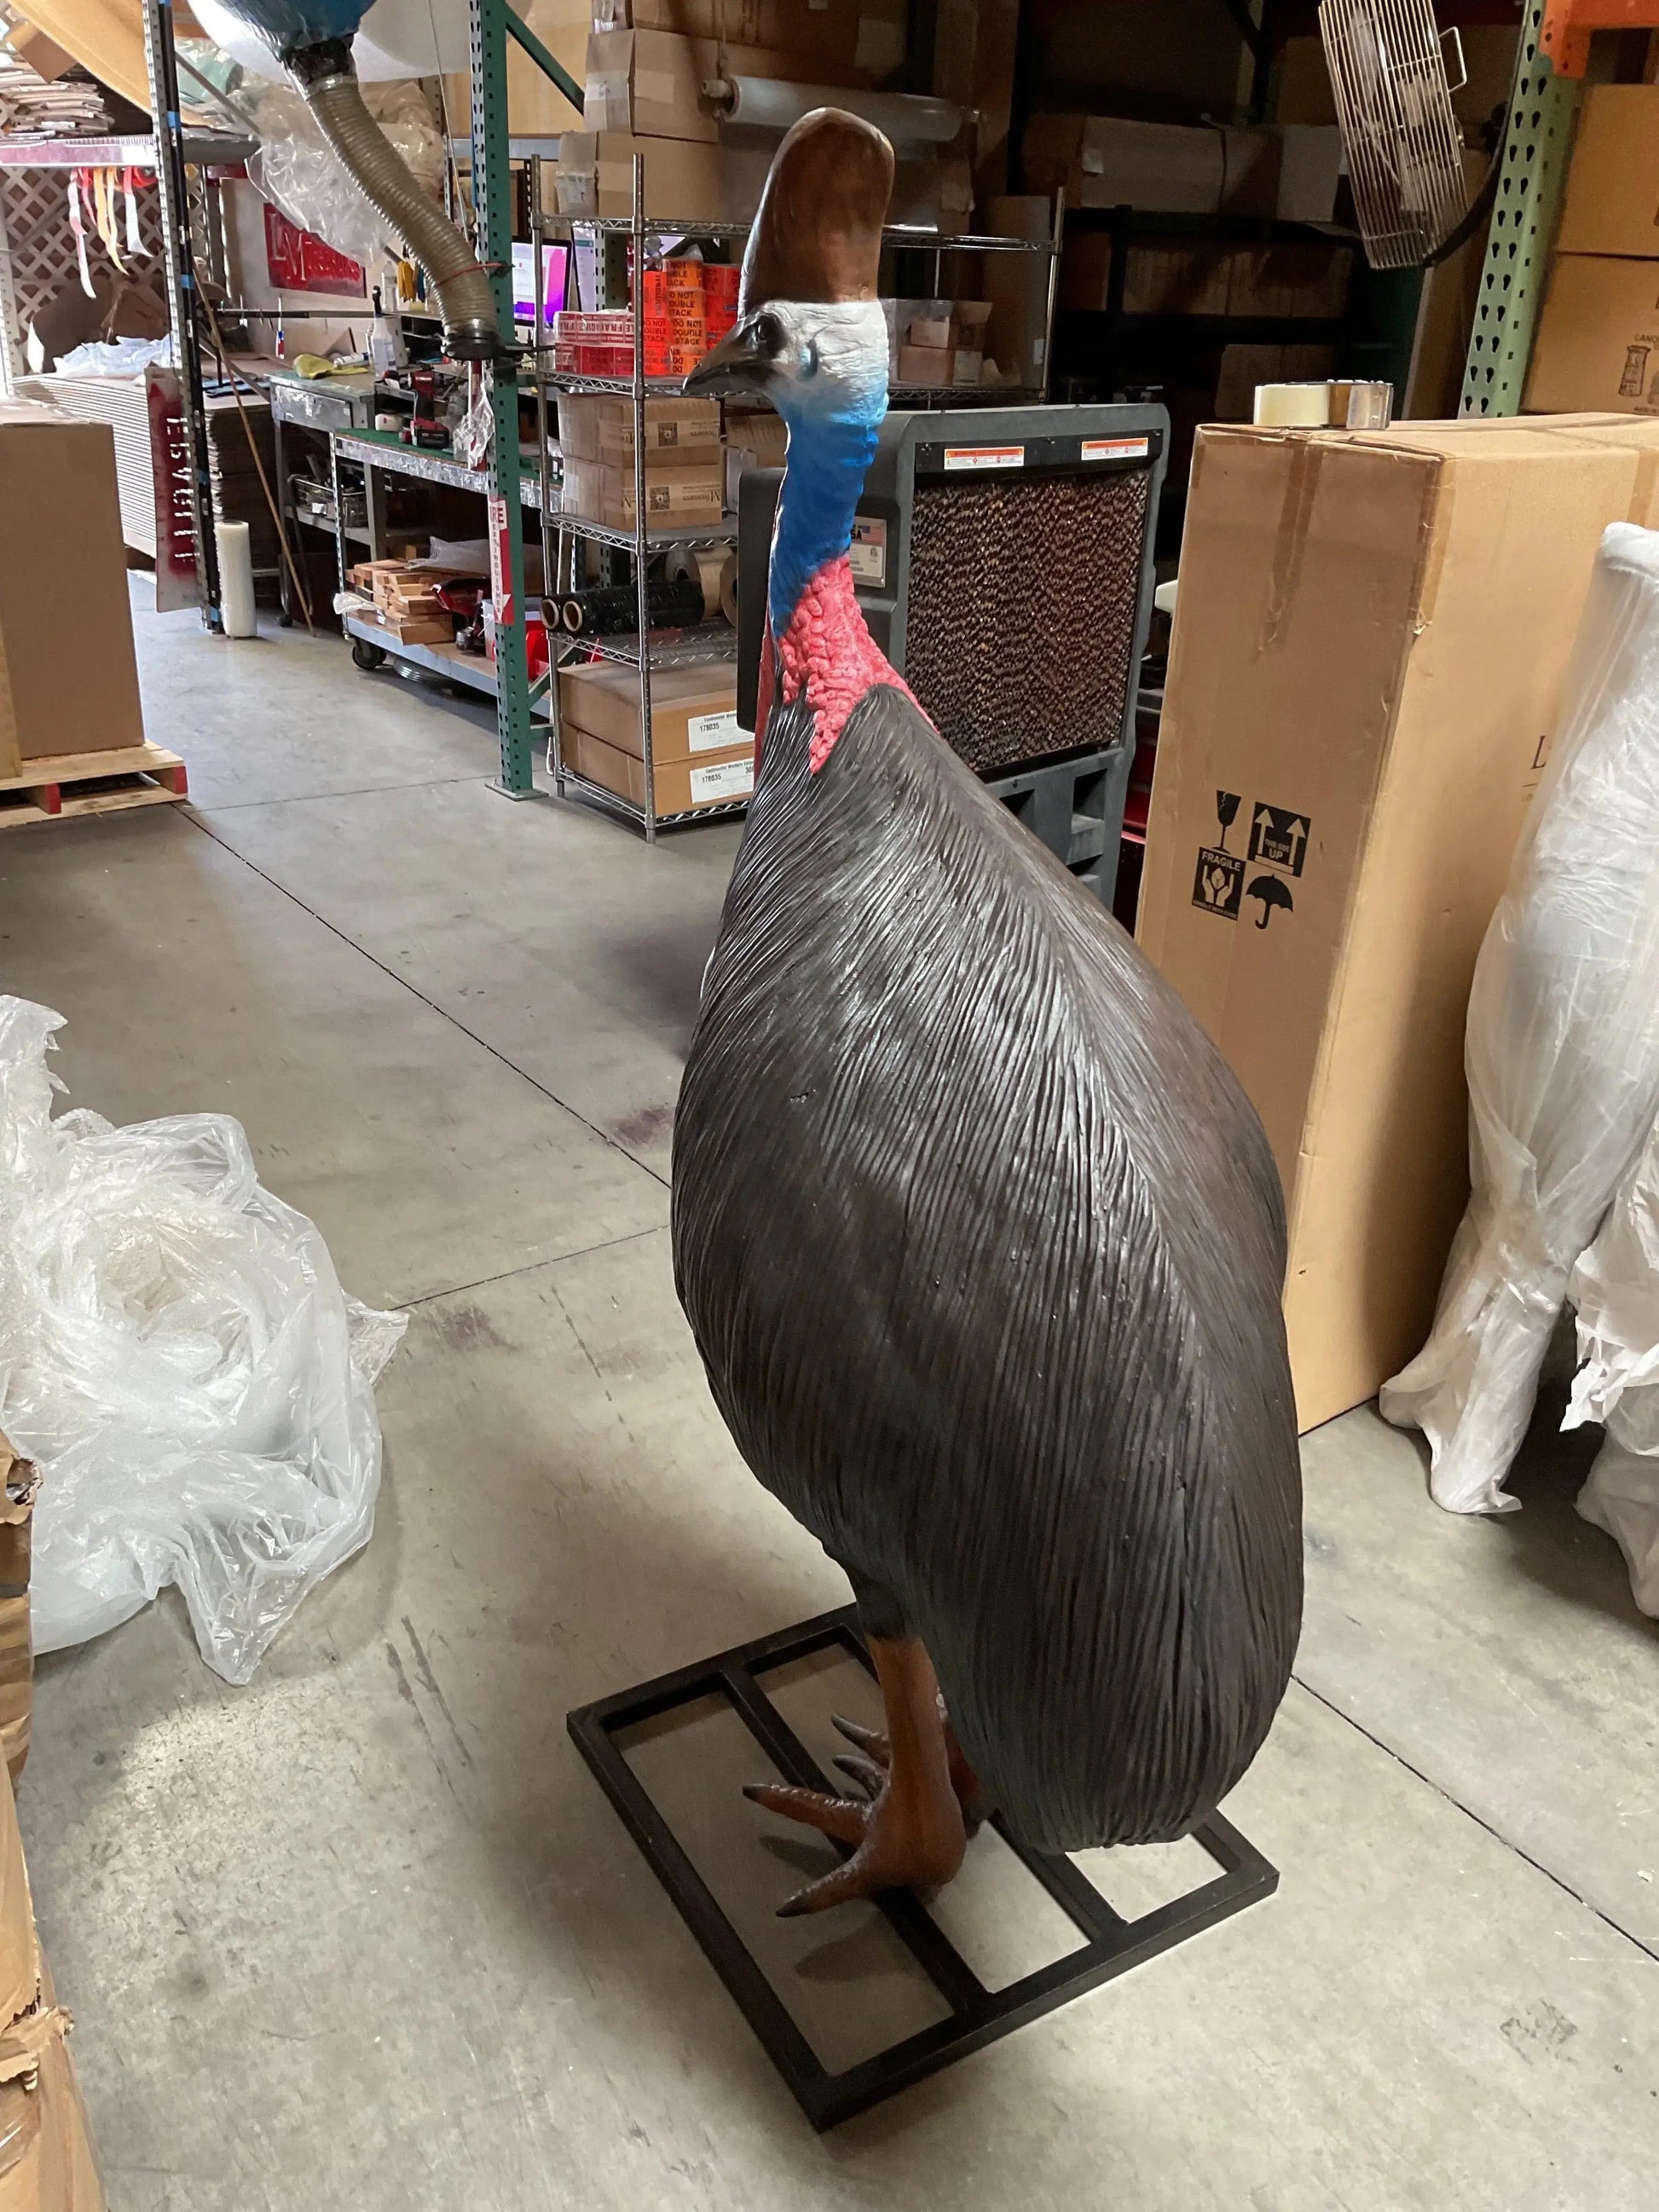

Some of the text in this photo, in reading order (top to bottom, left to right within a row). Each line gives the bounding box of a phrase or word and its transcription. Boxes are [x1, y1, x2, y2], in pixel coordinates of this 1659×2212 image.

[686, 320, 702, 328] NOT
[700, 723, 720, 732] 178035
[702, 774, 721, 783] 178035
[1269, 848, 1284, 860] UP
[1201, 851, 1241, 872] FRAGILE
